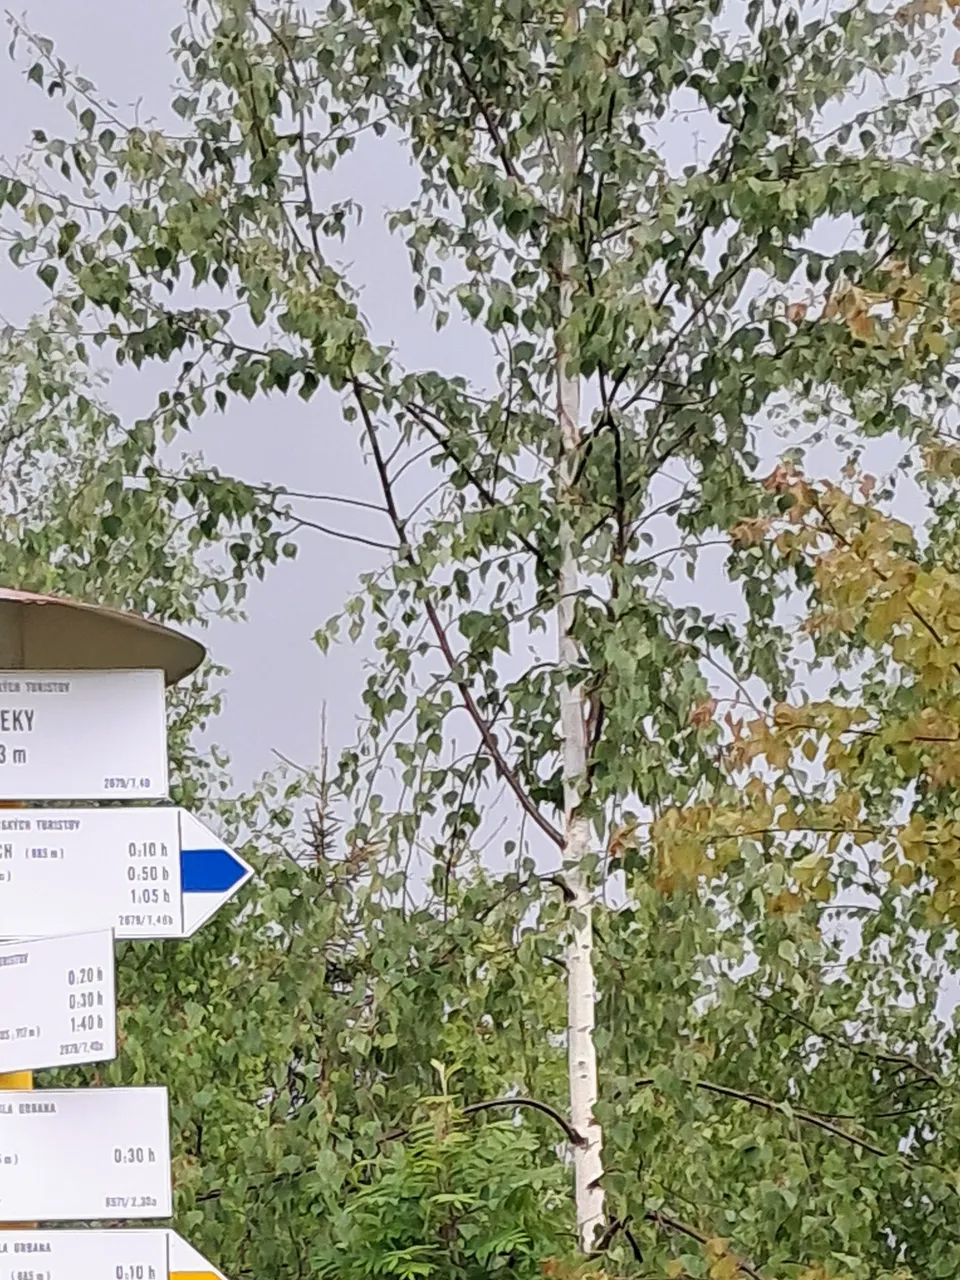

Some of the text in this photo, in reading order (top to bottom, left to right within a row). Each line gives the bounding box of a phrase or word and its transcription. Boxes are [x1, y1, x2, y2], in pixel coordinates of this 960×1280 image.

[12, 747, 27, 764] m
[36, 819, 80, 831] TURISTOV
[161, 842, 168, 857] h
[162, 866, 169, 881] h
[163, 888, 171, 903] h
[148, 1148, 155, 1162] h
[148, 1265, 156, 1280] h
